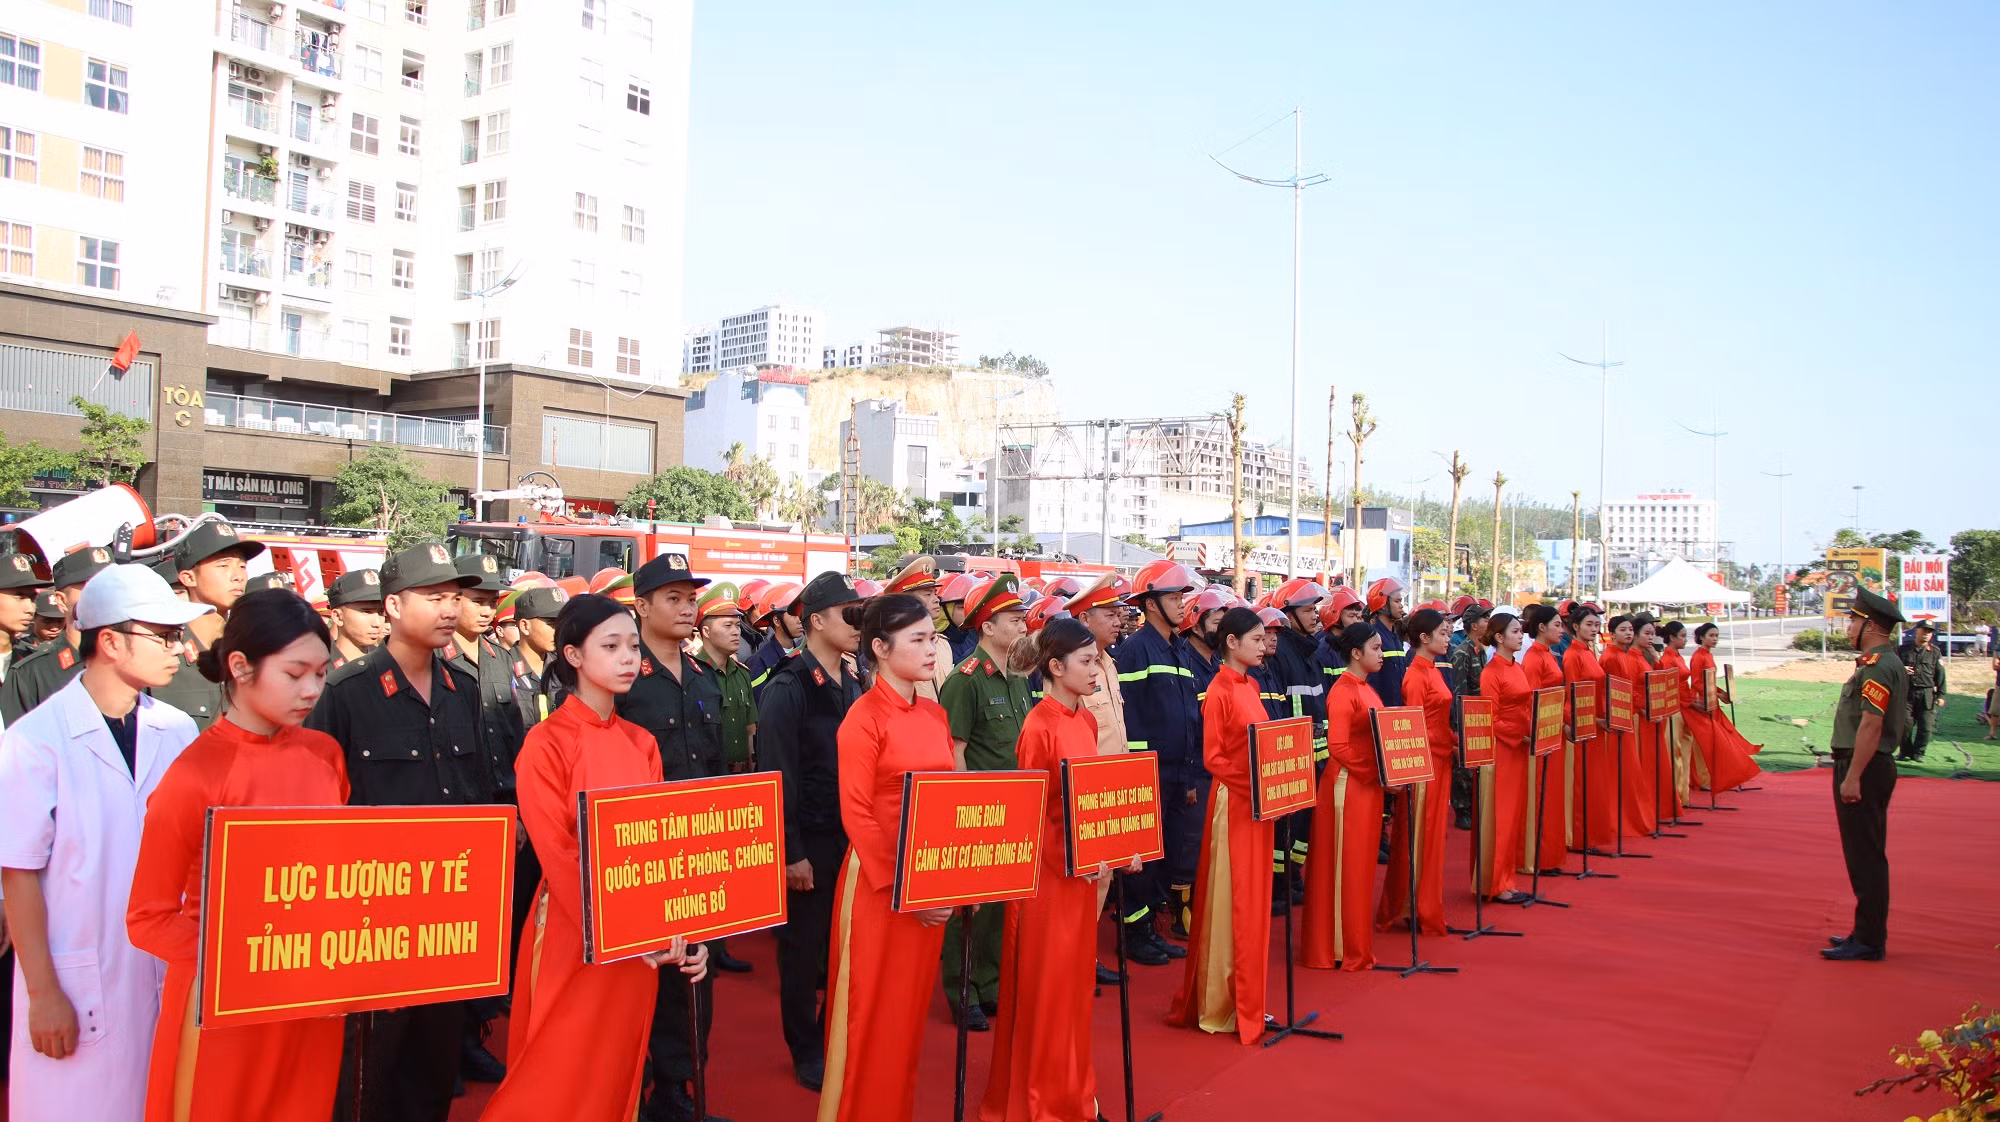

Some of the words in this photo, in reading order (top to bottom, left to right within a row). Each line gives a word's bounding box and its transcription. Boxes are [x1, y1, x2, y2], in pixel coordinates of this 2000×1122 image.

[164, 385, 203, 407] TÒA
[176, 410, 191, 427] C
[215, 472, 235, 491] HẢI
[236, 474, 259, 492] SẢN
[260, 480, 275, 496] HẠ
[276, 480, 304, 495] LONG
[1925, 557, 1943, 574] MỐI
[1904, 575, 1921, 591] HẢI
[1924, 576, 1945, 592] SẢN
[1078, 790, 1099, 811] PHÒNG
[1100, 787, 1116, 809] CẢNH
[1117, 786, 1128, 806] SÁT
[1129, 786, 1137, 804] CƠ
[1137, 784, 1153, 805] ĐỘNG
[614, 818, 658, 848] TRUNG
[661, 812, 689, 841] TÂM
[691, 803, 725, 836] HUẤN
[727, 802, 764, 833] LUYỆN
[956, 804, 983, 829] TRUNG
[983, 800, 1006, 827] ĐOÀN
[1079, 820, 1096, 840] CÔNG
[1097, 821, 1106, 837] AN
[1106, 814, 1121, 836] TỈNH
[1121, 811, 1140, 835] QUẢNG
[1140, 812, 1155, 830] NINH
[605, 856, 640, 894] QUỐC
[644, 860, 667, 885] GIA
[669, 849, 685, 881] VỀ
[687, 847, 733, 877] PHÒNG,
[735, 837, 775, 869] CHỐNG
[915, 840, 940, 872] CẢNH
[941, 842, 959, 871] SÁT
[960, 843, 972, 869] CƠ
[971, 840, 994, 872] ĐỘNG
[994, 839, 1016, 866] ĐÔNG
[1017, 834, 1034, 864] BẮC
[264, 862, 318, 910] LỰC
[325, 859, 411, 906] LƯỢNG
[420, 861, 435, 895] Y
[442, 849, 471, 893] TẾ
[665, 888, 707, 922] KHỦNG
[710, 881, 726, 914] BỐ
[247, 923, 312, 973] TỈNH
[320, 917, 410, 971] QUẢNG
[418, 921, 478, 959] NINH
